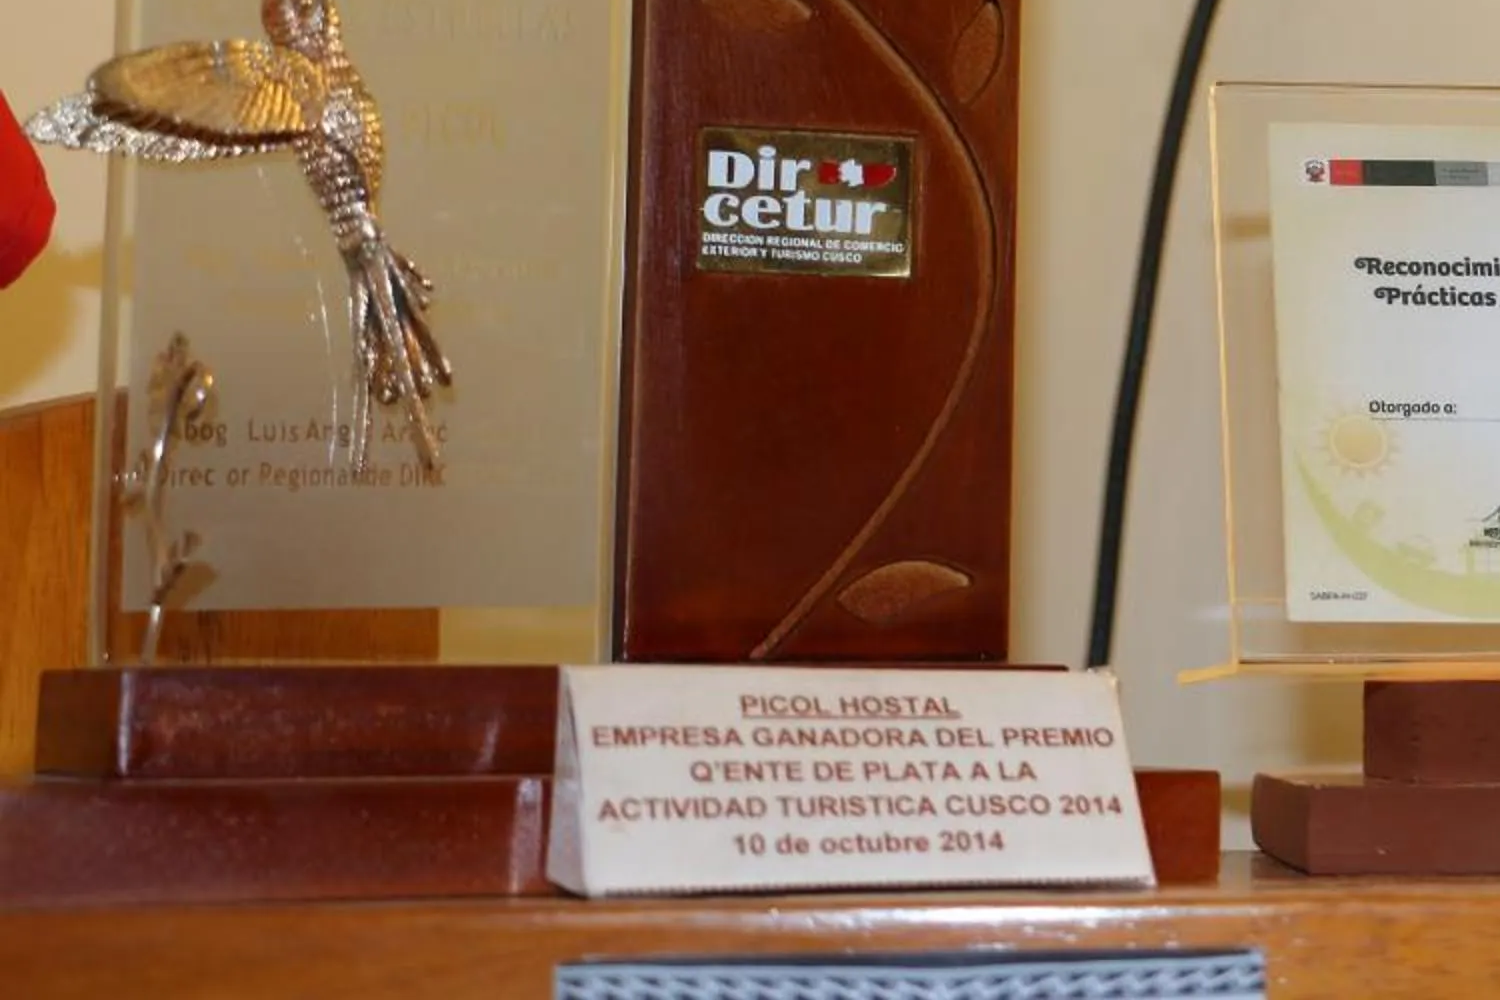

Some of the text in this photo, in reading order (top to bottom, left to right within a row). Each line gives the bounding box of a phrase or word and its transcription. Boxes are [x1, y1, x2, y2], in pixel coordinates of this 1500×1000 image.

[708, 145, 812, 191] Dir
[703, 190, 888, 235] cetur
[702, 245, 863, 263] EXTERIOR Y TURISMO CUSCO
[703, 232, 904, 253] DIRECCION REGIONAL DE COMERCIO
[1374, 284, 1497, 307] Prácticas
[1369, 400, 1457, 417] Otorgado a:
[248, 416, 299, 443] Luis
[740, 695, 958, 717] PICOL HOSTAL
[591, 726, 1115, 748] EMPRESA GANADORA DEL PREMIO
[690, 760, 1038, 783] Q'ENTE DE PLATA A LA
[597, 794, 1123, 821] ACTIVIDAD TURISTICA CUSCO 2014
[735, 831, 1006, 856] 10 de octubre 2014
